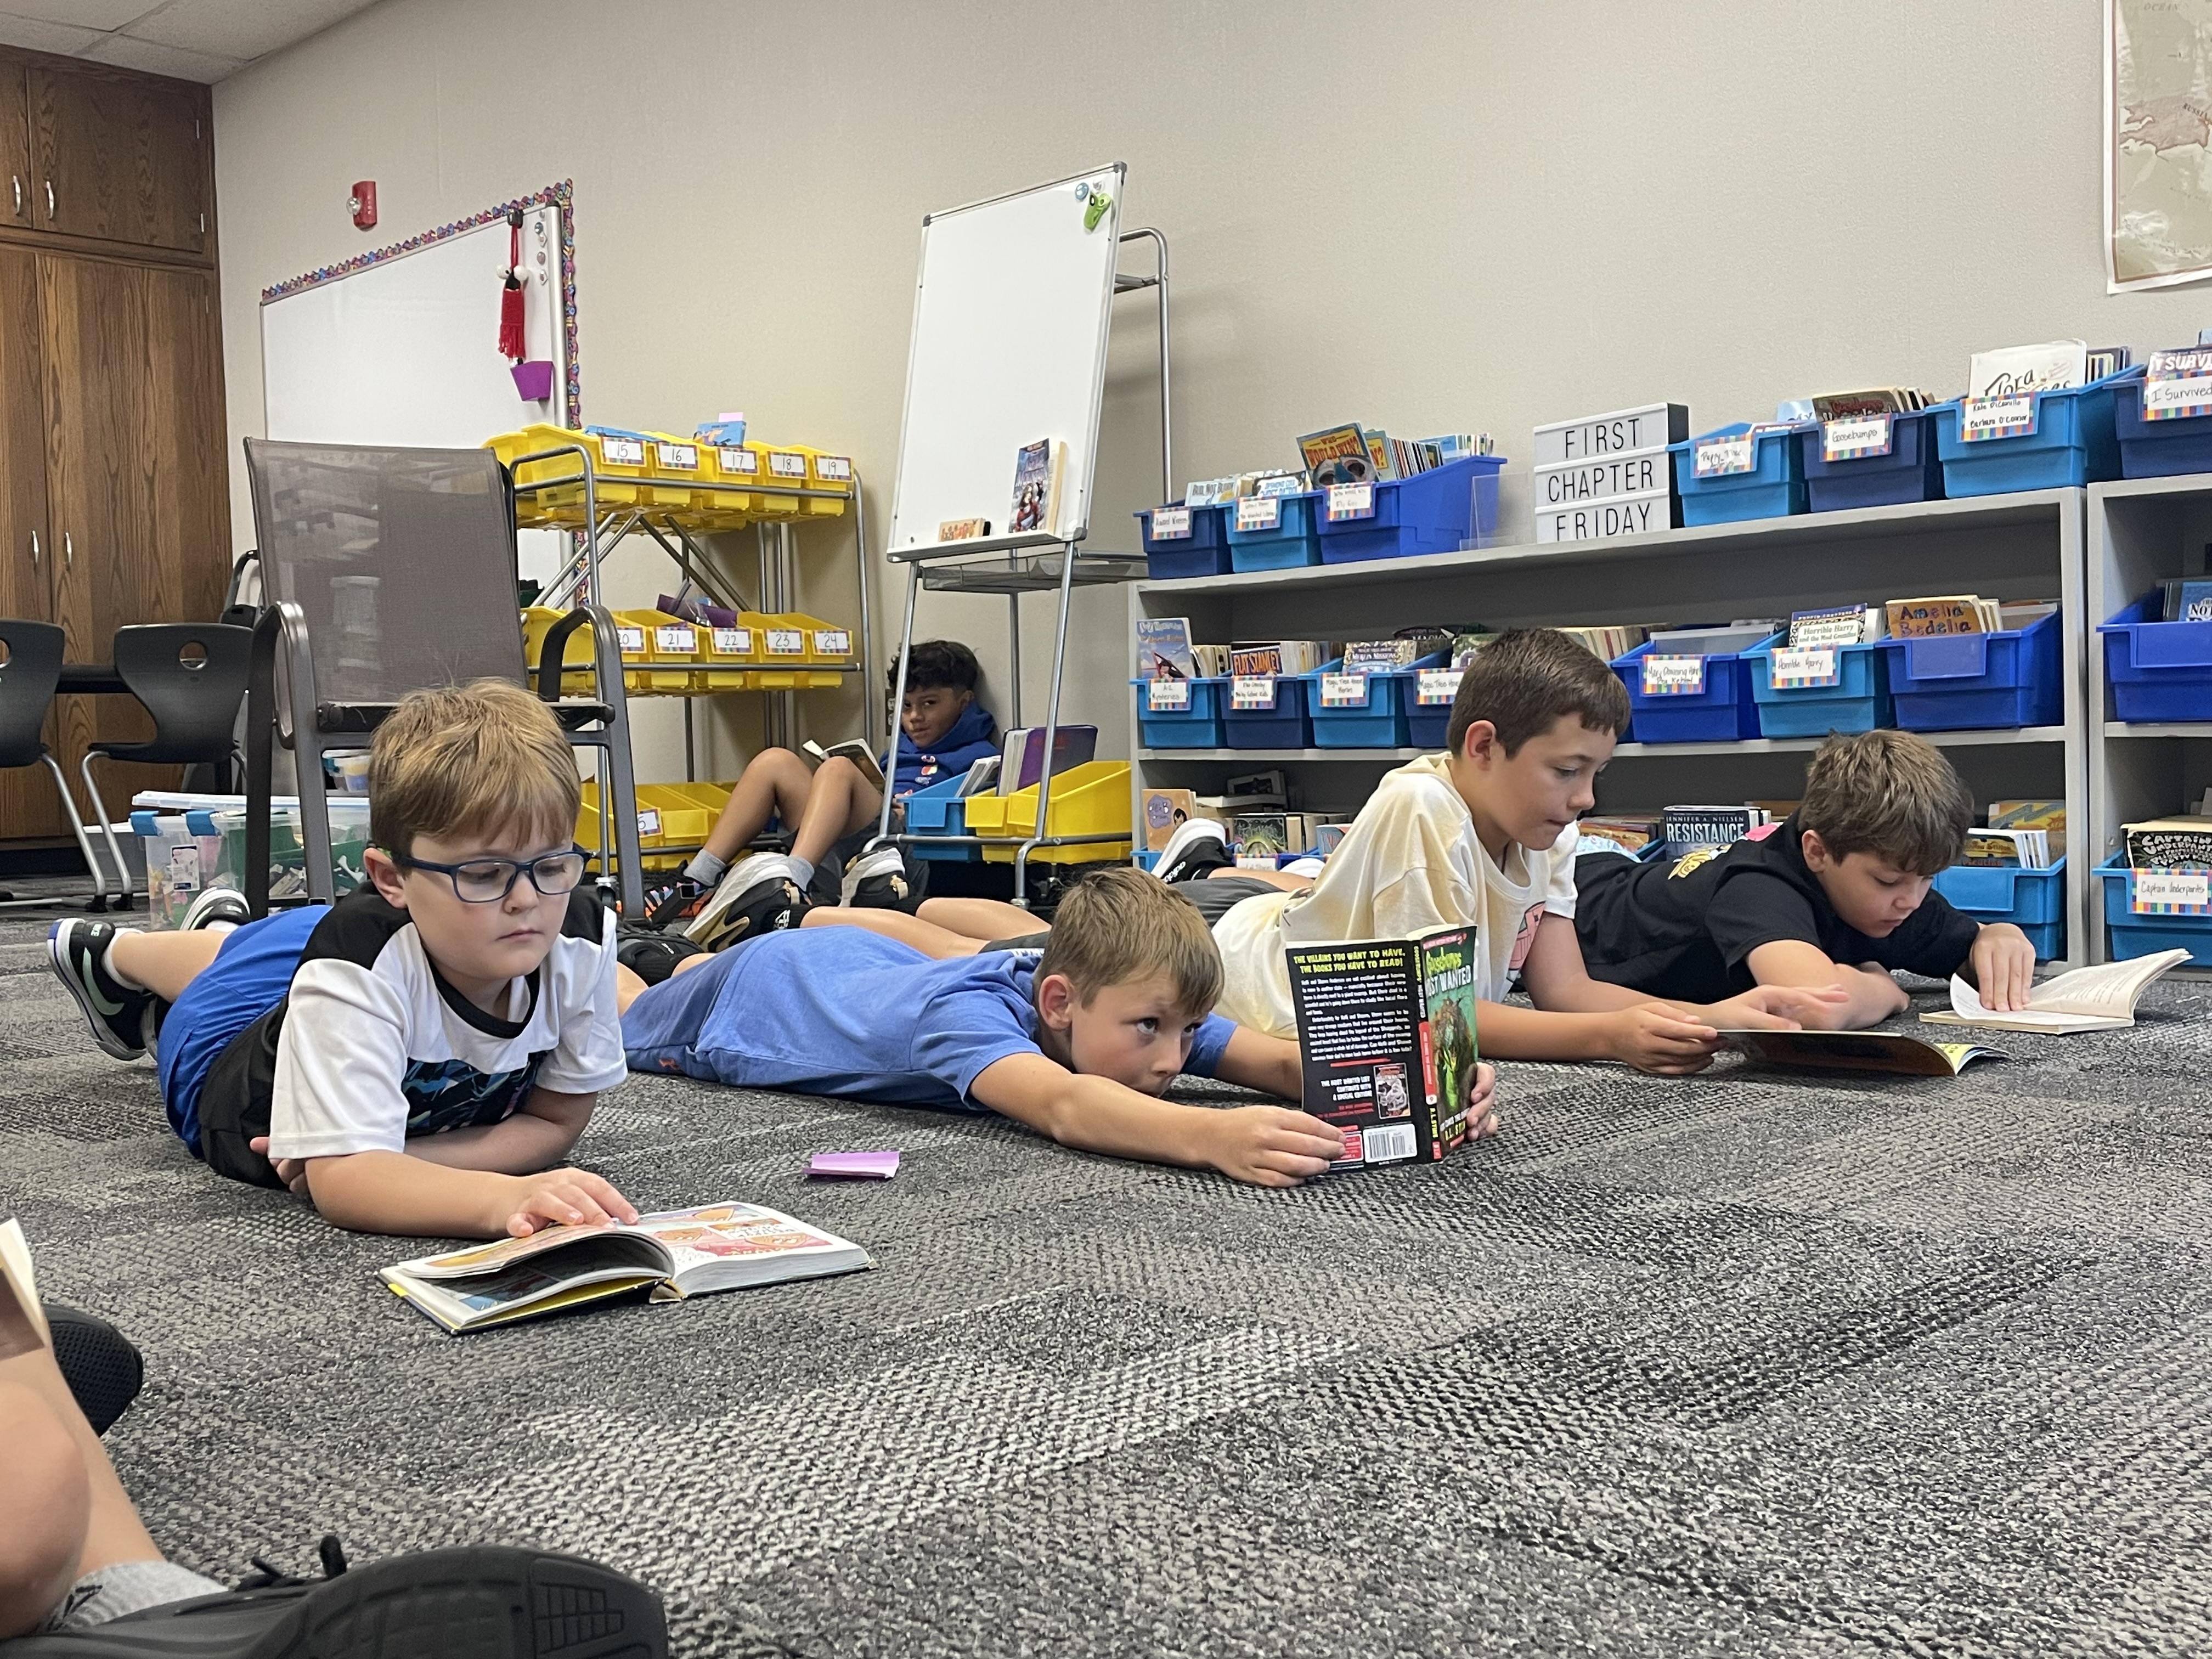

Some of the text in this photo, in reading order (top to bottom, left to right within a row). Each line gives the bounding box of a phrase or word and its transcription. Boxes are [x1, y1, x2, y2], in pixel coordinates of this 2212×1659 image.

[2151, 382, 2212, 404] I Survived
[1973, 403, 1987, 413] Kate
[1320, 435, 1338, 445] WHO
[1565, 417, 1640, 459] FIRST
[1832, 428, 1878, 443] Goosebumps
[617, 443, 629, 458] 15
[671, 448, 682, 462] 16
[1305, 436, 1361, 468] WOULD WIN?
[732, 453, 744, 467] 17
[782, 456, 792, 471] 18
[827, 460, 837, 475] 19
[1548, 460, 1654, 503] CHAPTER
[1556, 501, 1651, 542] FRIDAY
[1900, 605, 1965, 620] Amelia
[1804, 624, 1854, 636] Horrible Harry
[1899, 618, 1972, 638] Bedelia
[667, 633, 680, 646] 21
[724, 634, 739, 646] 22
[775, 633, 790, 647] 23
[823, 634, 838, 648] 24
[1234, 650, 1281, 676] FLAT STANLEY
[637, 815, 646, 830] 5
[1666, 823, 1745, 843] RESISTANCE
[2142, 834, 2212, 846] CAPTAIN
[2142, 842, 2212, 855] UNDERPANT
[2141, 881, 2205, 896] Captain Underpants
[1294, 955, 1306, 964] THE
[1306, 953, 1333, 963] VILLAINS
[1333, 953, 1346, 961] YOU
[1346, 951, 1367, 960] WANT
[1369, 950, 1380, 958] TO
[1300, 957, 1404, 974] THE BOOKS YOU HAVE TO READ!
[1438, 964, 1472, 992] WANTED
